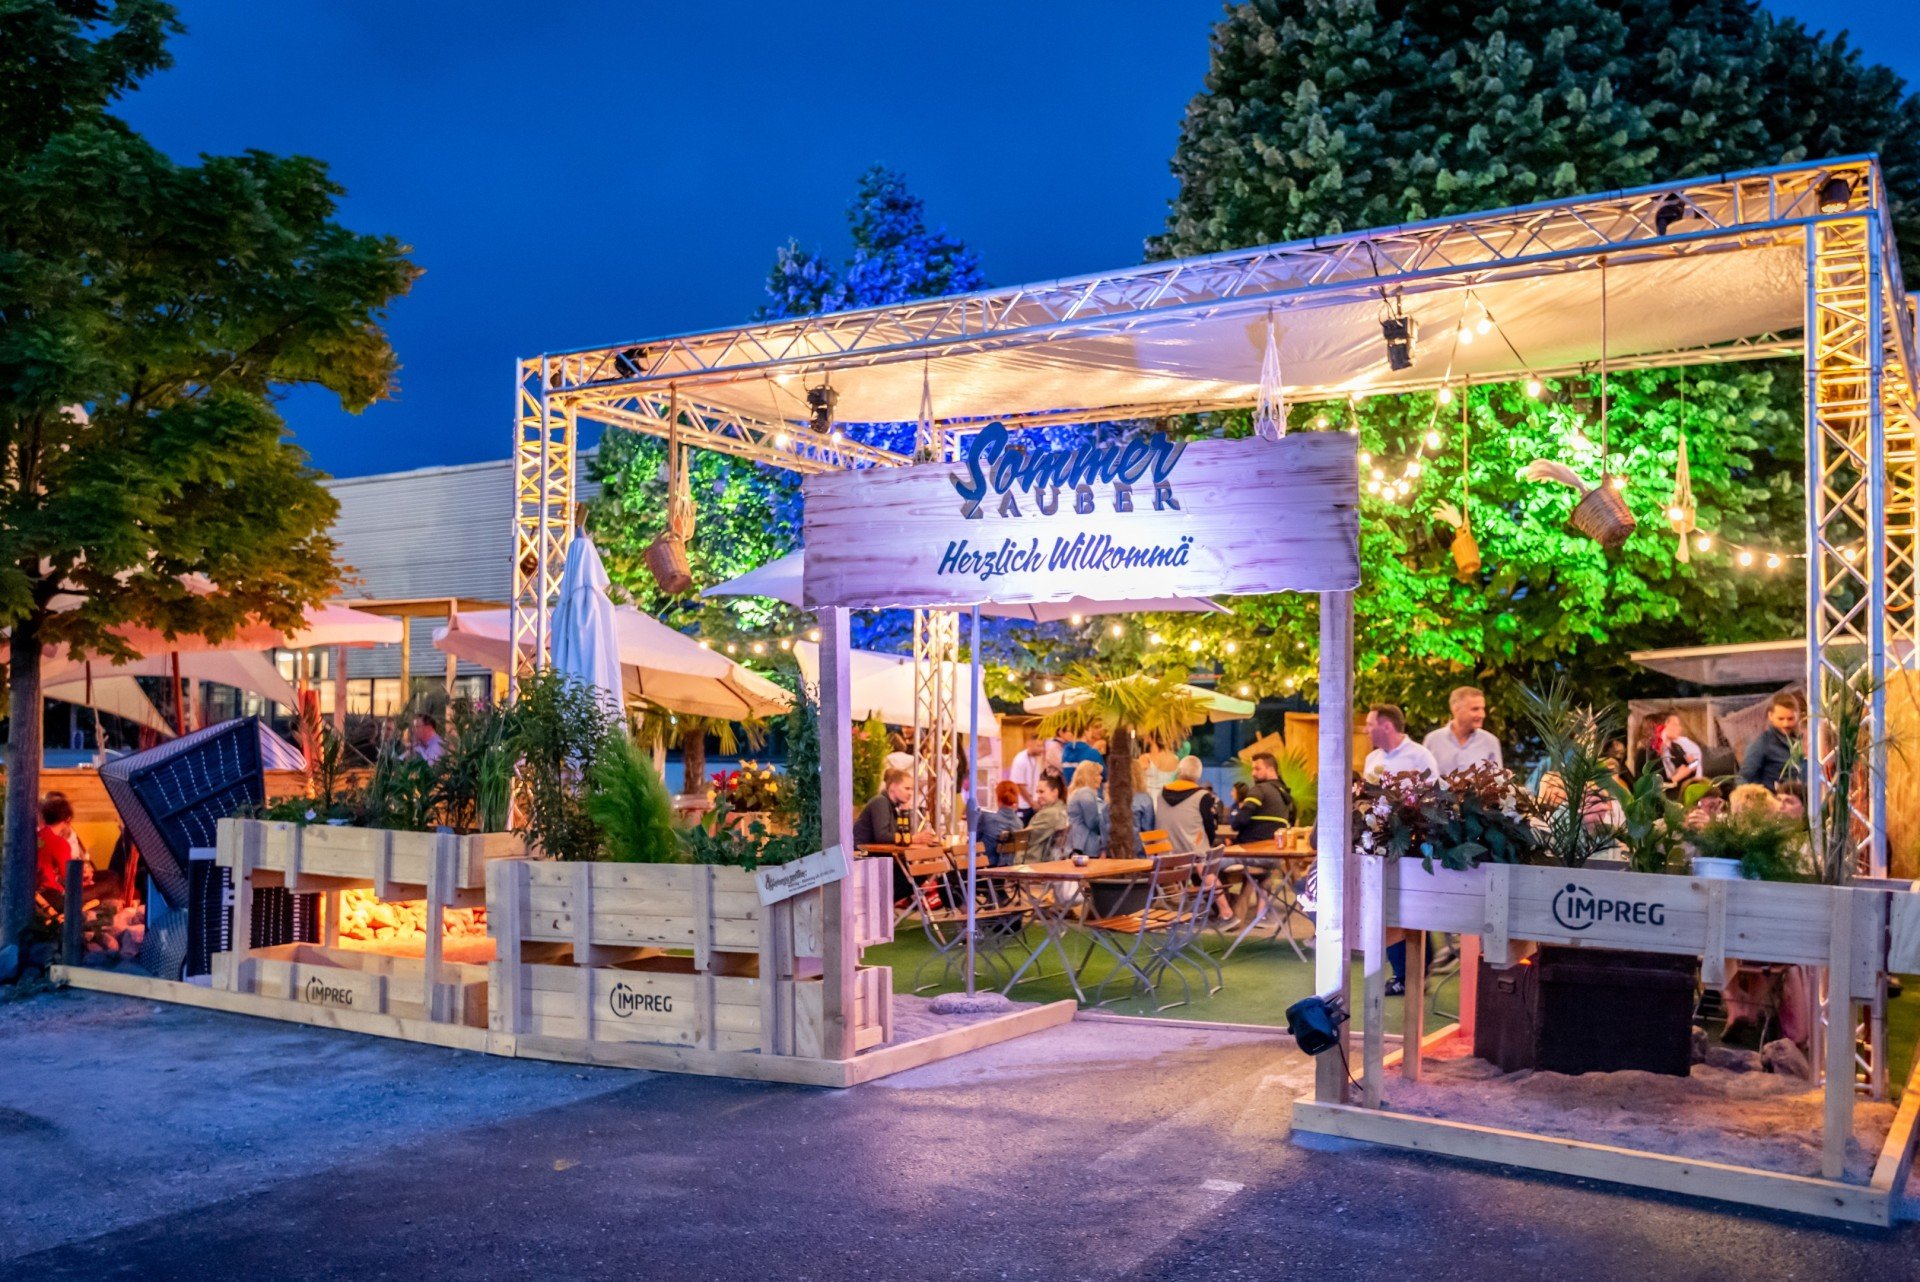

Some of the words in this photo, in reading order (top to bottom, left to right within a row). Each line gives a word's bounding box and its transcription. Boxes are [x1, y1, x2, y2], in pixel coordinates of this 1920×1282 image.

[954, 421, 1187, 501] Sommer
[937, 537, 1047, 581] Herzlich
[1048, 532, 1194, 572] Willkommä
